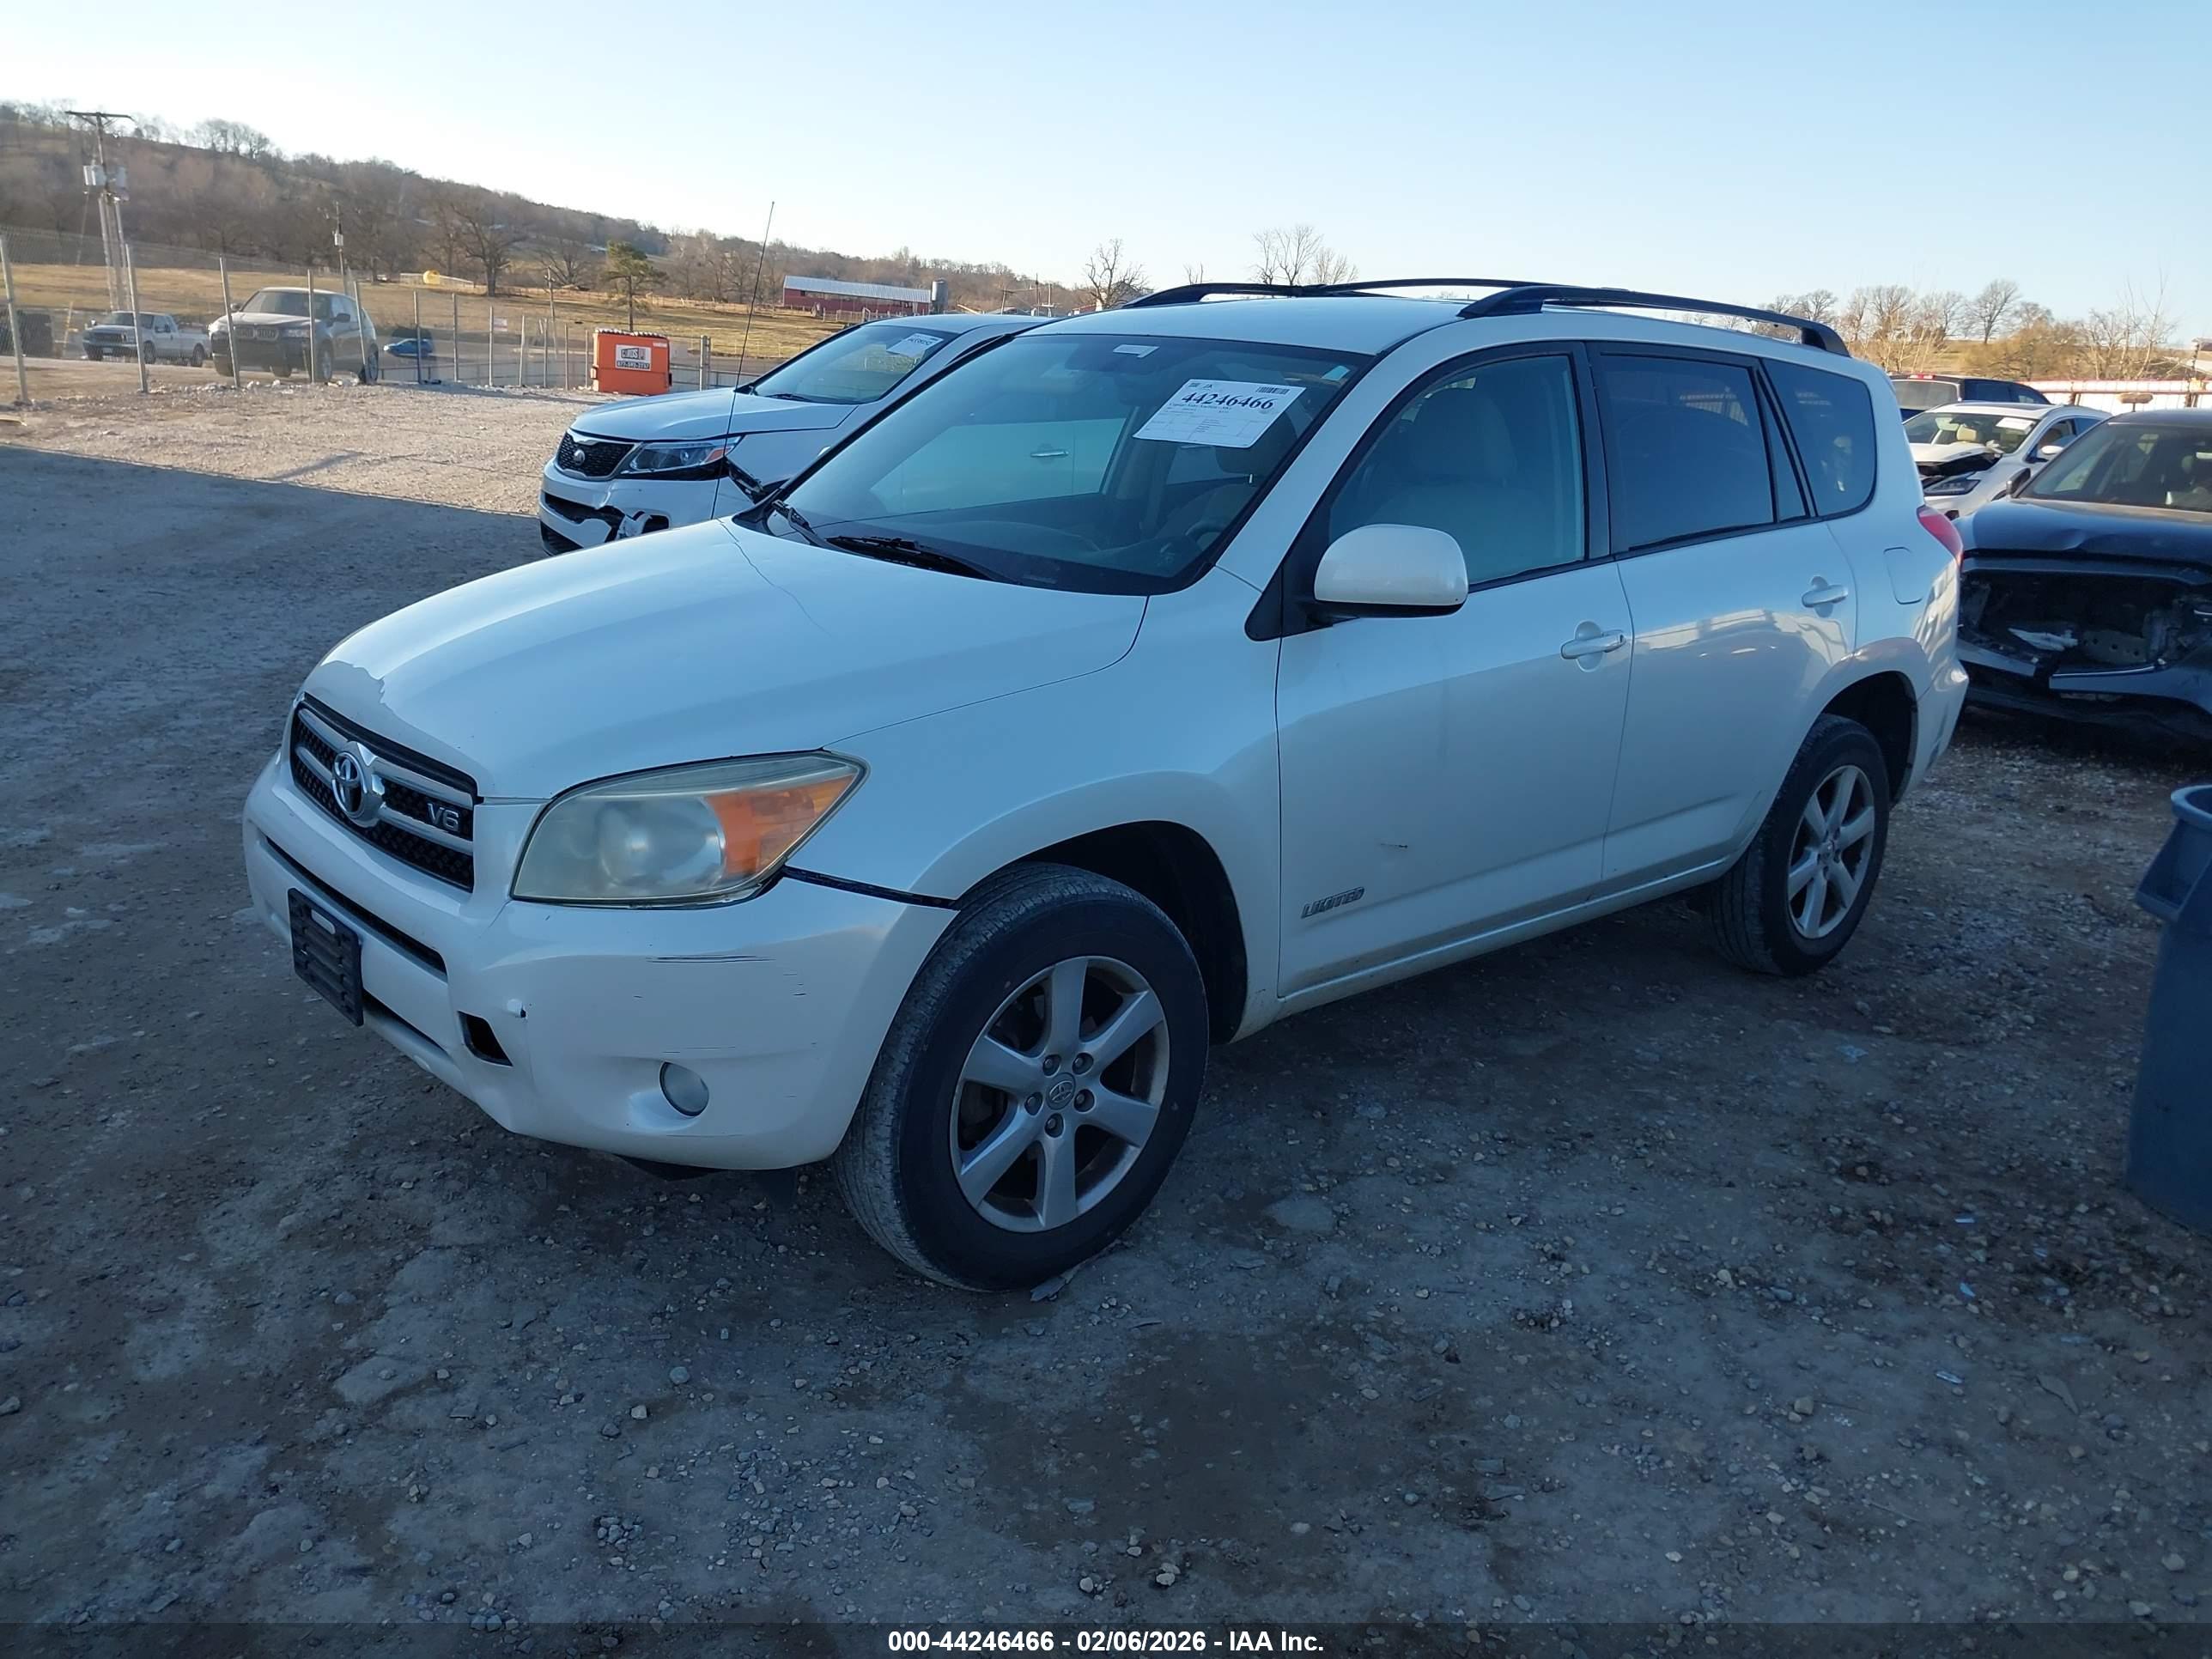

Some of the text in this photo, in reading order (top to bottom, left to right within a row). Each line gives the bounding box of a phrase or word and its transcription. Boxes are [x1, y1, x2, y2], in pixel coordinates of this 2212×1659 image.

[1181, 392, 1277, 410] 44246466
[427, 803, 459, 832] V6
[1301, 886, 1364, 919] LIMITED
